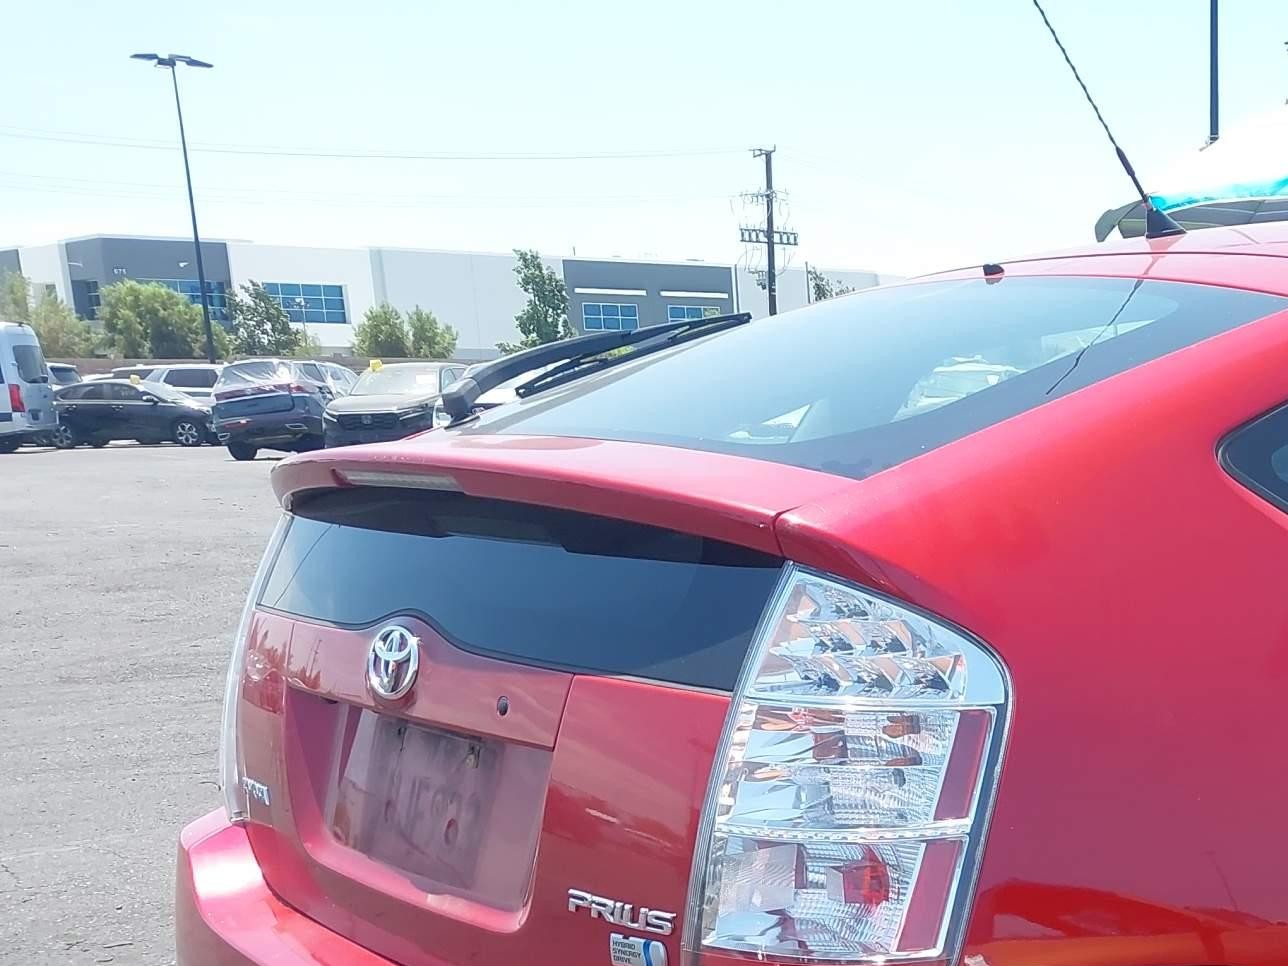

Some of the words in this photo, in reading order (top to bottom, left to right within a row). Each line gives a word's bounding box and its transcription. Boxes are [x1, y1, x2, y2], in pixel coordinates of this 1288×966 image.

[567, 888, 677, 936] PRIUS
[612, 941, 636, 950] HYBRID
[612, 947, 642, 960] SYNERGY
